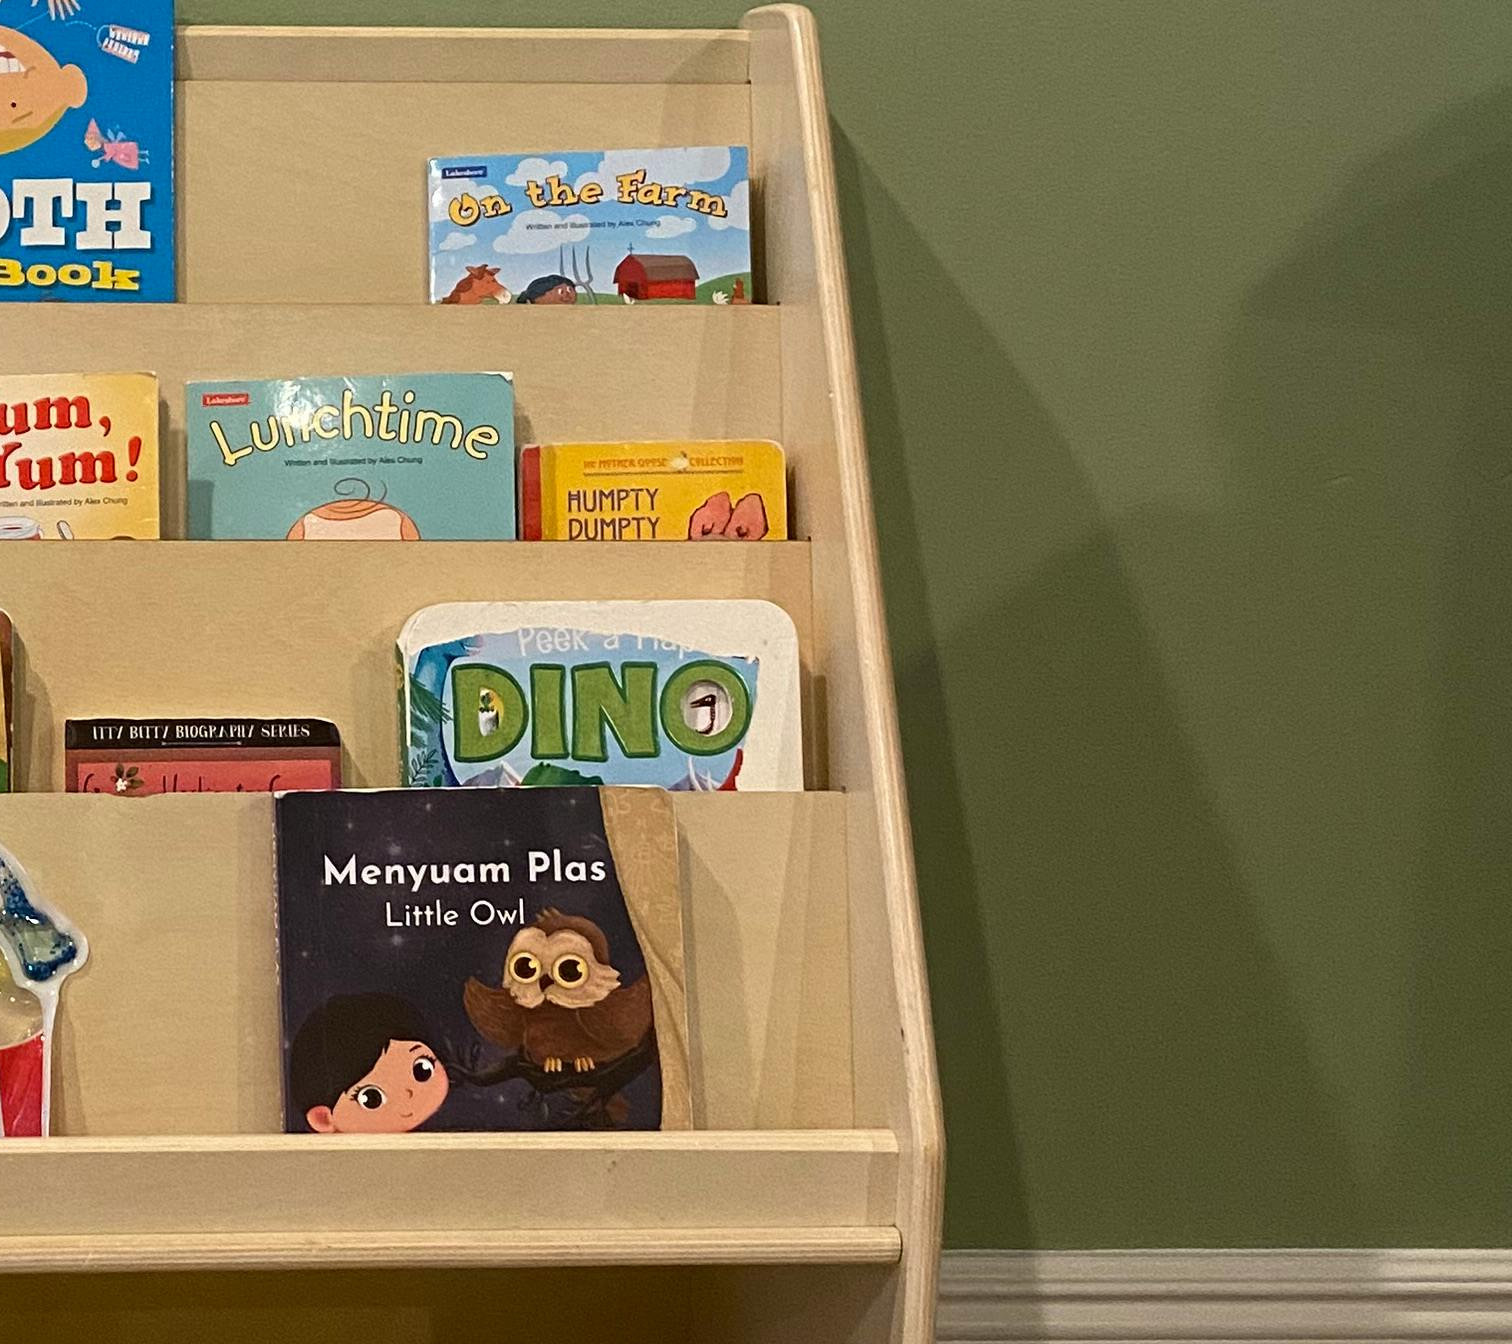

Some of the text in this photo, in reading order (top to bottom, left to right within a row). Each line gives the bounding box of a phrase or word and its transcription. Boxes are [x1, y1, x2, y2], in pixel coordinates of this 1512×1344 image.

[448, 169, 728, 227] On the Farm
[209, 389, 500, 467] Lunchtime
[313, 458, 328, 466] and
[367, 457, 377, 466] by
[397, 456, 423, 465] Chung
[19, 499, 35, 507] and
[35, 497, 72, 507] Illustrated
[73, 496, 83, 506] by
[102, 496, 129, 506] Chung
[567, 487, 660, 513] HUMPTY
[568, 516, 661, 541] DUMPTY
[517, 625, 590, 657] Peek
[451, 659, 753, 763] DINO
[92, 723, 311, 740] ITTY BITTY BIOGRAPHY SERIES
[324, 848, 607, 892] Menyuam Plas
[385, 897, 526, 927] Little Owl
